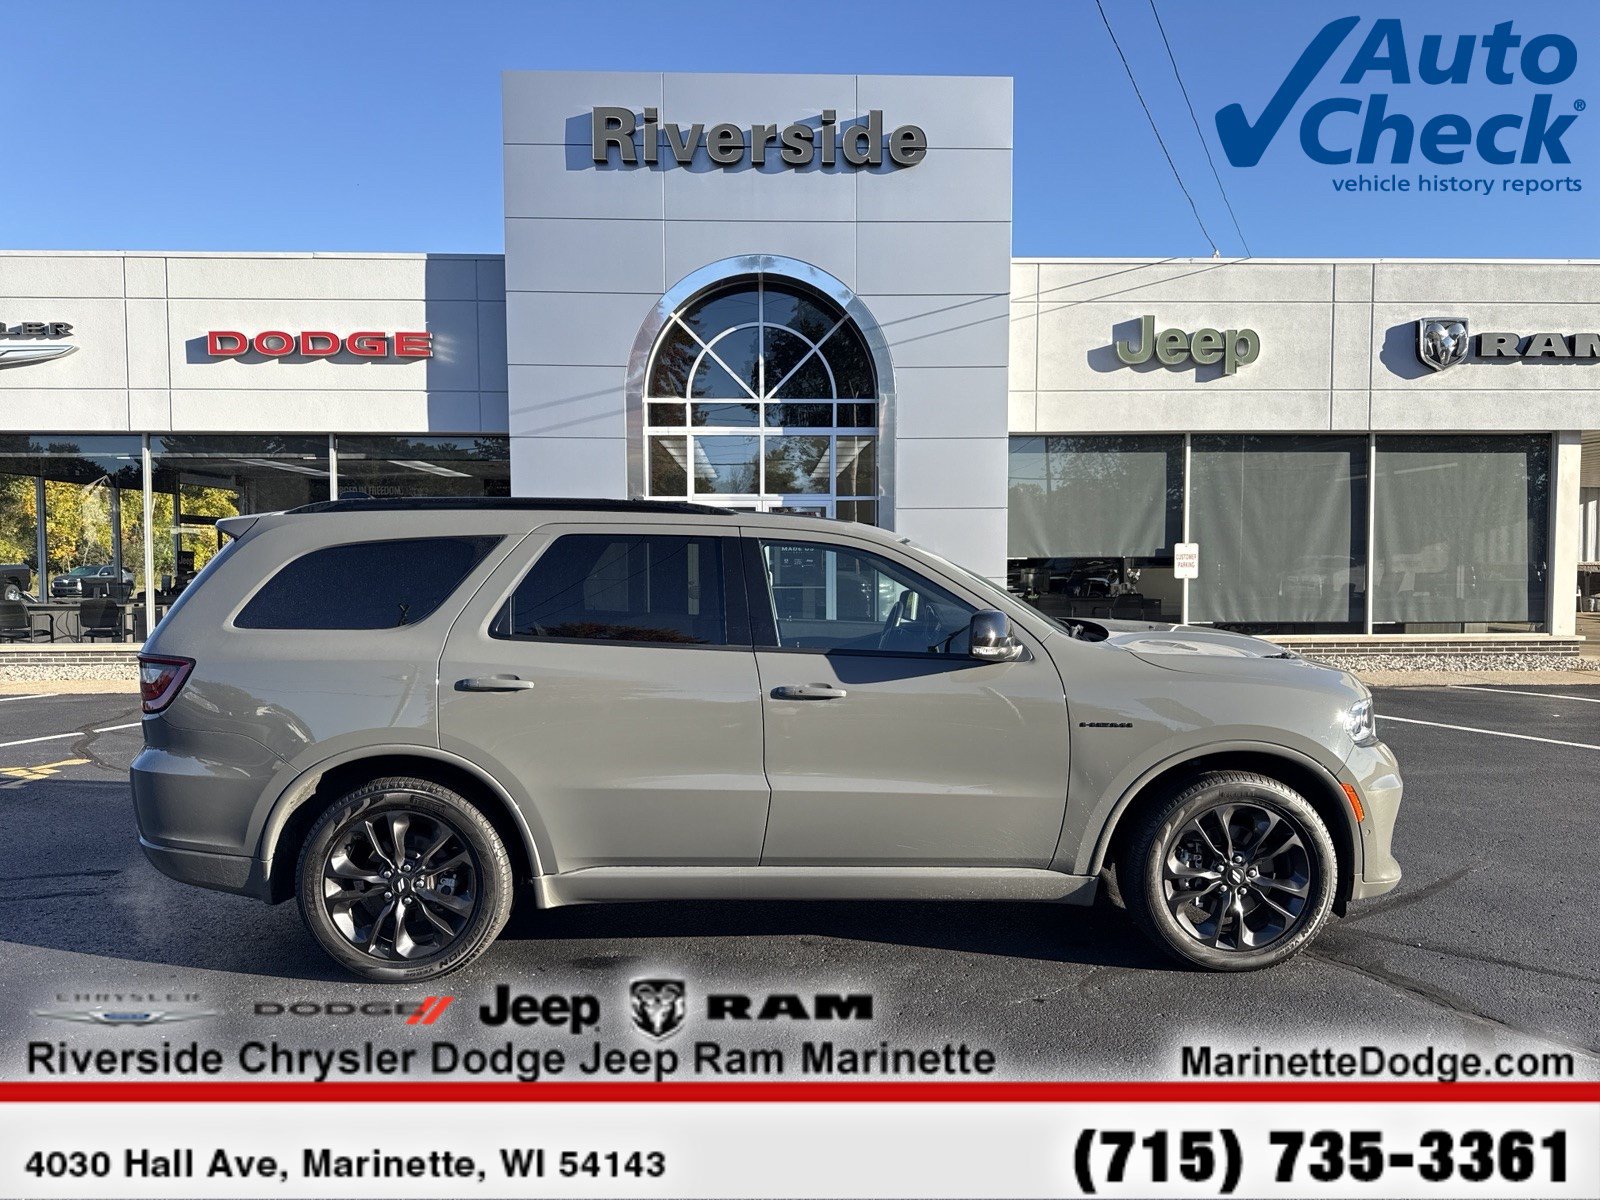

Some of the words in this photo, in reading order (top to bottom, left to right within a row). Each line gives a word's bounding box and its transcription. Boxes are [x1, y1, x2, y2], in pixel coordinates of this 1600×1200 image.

[592, 106, 927, 165] Riverside
[208, 331, 433, 357] DODGE
[1117, 315, 1260, 375] Jeep
